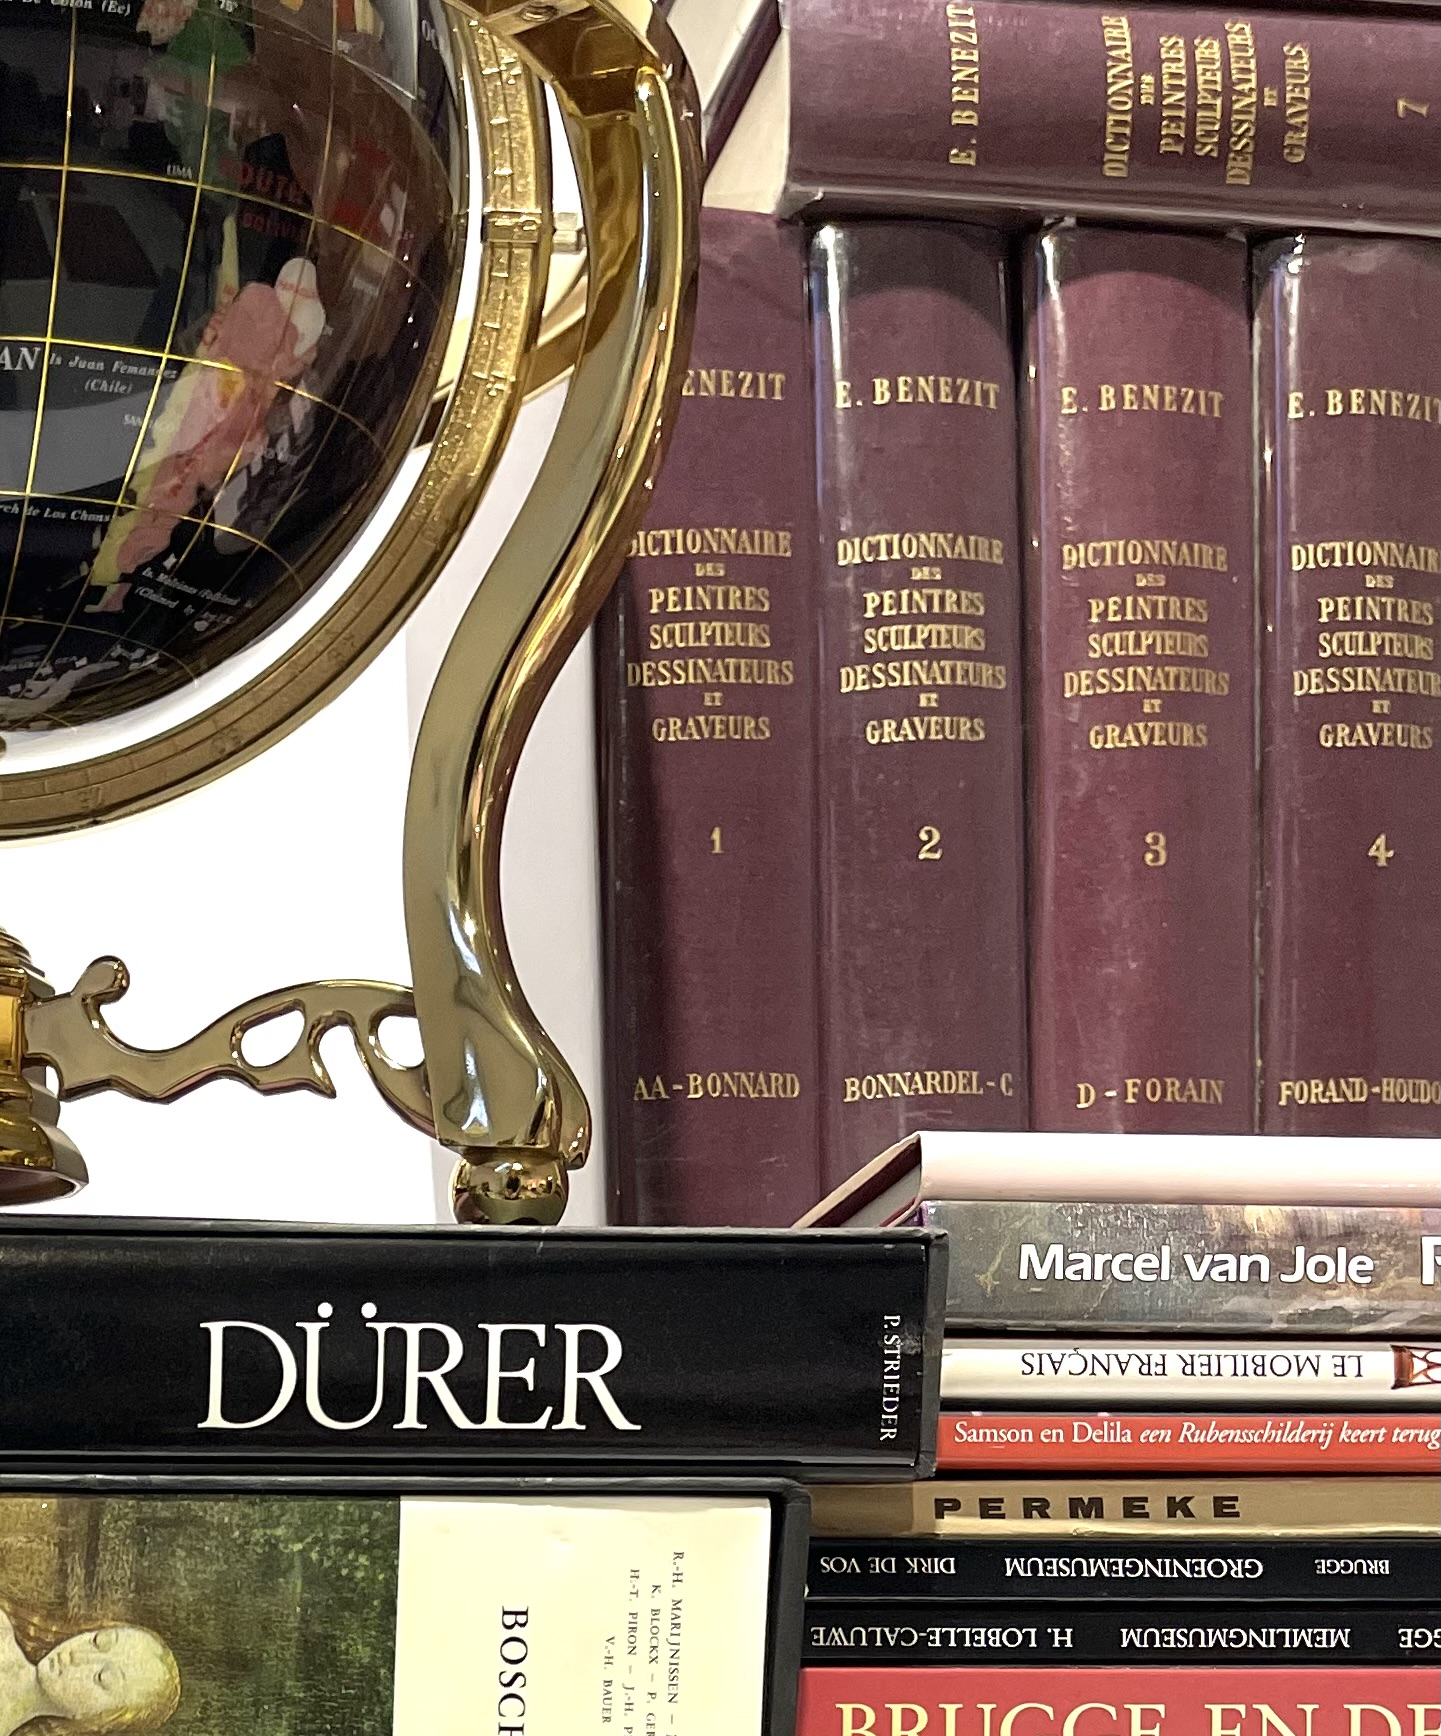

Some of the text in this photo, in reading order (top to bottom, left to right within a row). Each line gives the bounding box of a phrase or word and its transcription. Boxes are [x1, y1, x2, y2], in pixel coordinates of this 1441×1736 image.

[946, 4, 980, 166] E. BENEZIT
[1101, 15, 1134, 178] DICTIONNAIRE
[1159, 34, 1188, 156] PEINTRES
[1194, 35, 1223, 158] SCULPTEURS
[1224, 18, 1258, 186] DESSINATEURS
[1283, 42, 1311, 164] GRAVEURS
[1396, 97, 1430, 119] 7
[835, 376, 1001, 410] E. BENEZIT
[1061, 384, 1225, 419] E. BENEZIT
[837, 532, 1005, 567] DICTIONNAIRE
[1062, 539, 1228, 572] DICTIONNAIRE
[649, 585, 770, 614] PEINTRES
[863, 588, 985, 618] PEINTRES
[1088, 595, 1209, 624] PEINTRES
[1317, 596, 1434, 626] PEINTRES
[649, 621, 771, 650] SCULPTEURS
[863, 624, 986, 655] SCULPTEURS
[1088, 630, 1209, 659] SCULPTEURS
[1318, 631, 1434, 661] SCULPTEURS
[627, 657, 794, 688] DESSINATEURS
[839, 660, 1008, 694] DESSINATEURS
[1064, 666, 1231, 698] DESSINATEURS
[652, 715, 771, 742] GRAVEURS
[865, 716, 986, 745] GRAVEURS
[1089, 721, 1209, 750] GRAVEURS
[1319, 723, 1434, 750] GRAVEURS
[710, 827, 725, 854] 1
[918, 826, 944, 862] 2
[1144, 832, 1168, 867] 3
[1369, 834, 1395, 868] 4
[1018, 1243, 1375, 1285] Marcel van Jole
[197, 1301, 643, 1431] DÜRER
[1020, 1345, 1364, 1379] LE MOBILIER FRANÇAIS
[954, 1420, 1441, 1451] Samson en Delila een Rubensschilderij keert terug
[934, 1495, 1242, 1521] PERMEKE
[820, 1556, 1391, 1579] DIRK DE VOS GROENINGEMUSEUM BRUGGE
[626, 1611, 639, 1657] PIRON
[648, 1607, 662, 1666] BLOCKX
[810, 1626, 1351, 1649] H. LOBELLE-CALUWE MEMLINGMUSEUM
[665, 1598, 684, 1705] MARIJNISSEN
[601, 1678, 614, 1725] BAUER
